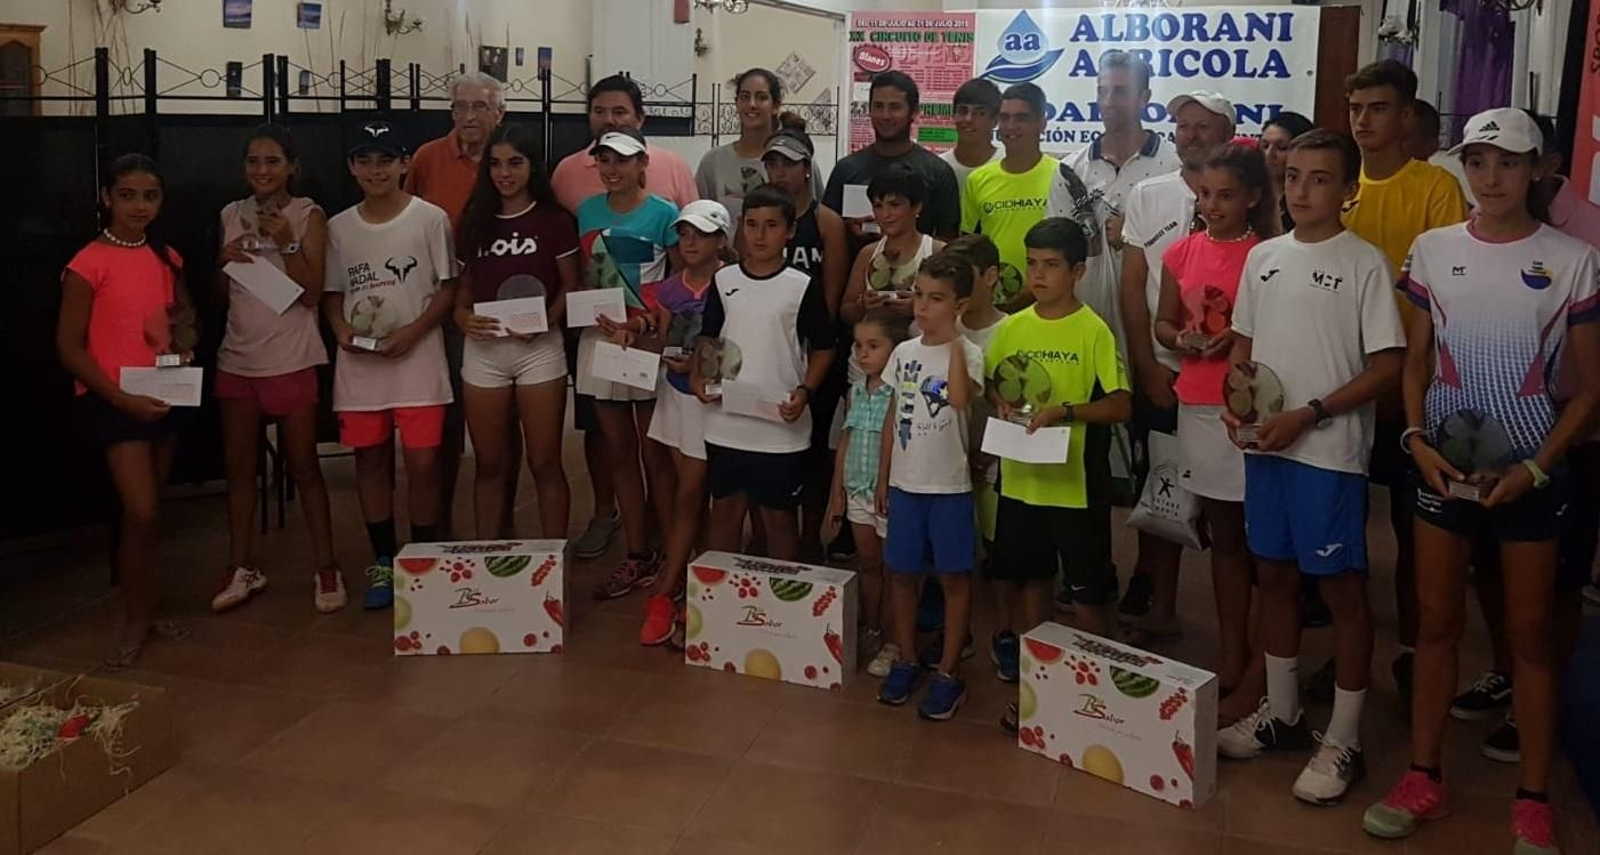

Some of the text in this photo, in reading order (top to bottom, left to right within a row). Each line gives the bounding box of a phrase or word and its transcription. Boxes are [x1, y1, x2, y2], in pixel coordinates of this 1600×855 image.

[870, 31, 921, 42] CIRCUITO
[924, 31, 938, 42] DE
[941, 31, 974, 43] TENIS
[1069, 12, 1294, 43] ALBORANI
[1005, 33, 1040, 51] aa
[1069, 49, 1291, 78] ARICOLA
[478, 231, 538, 258] ois
